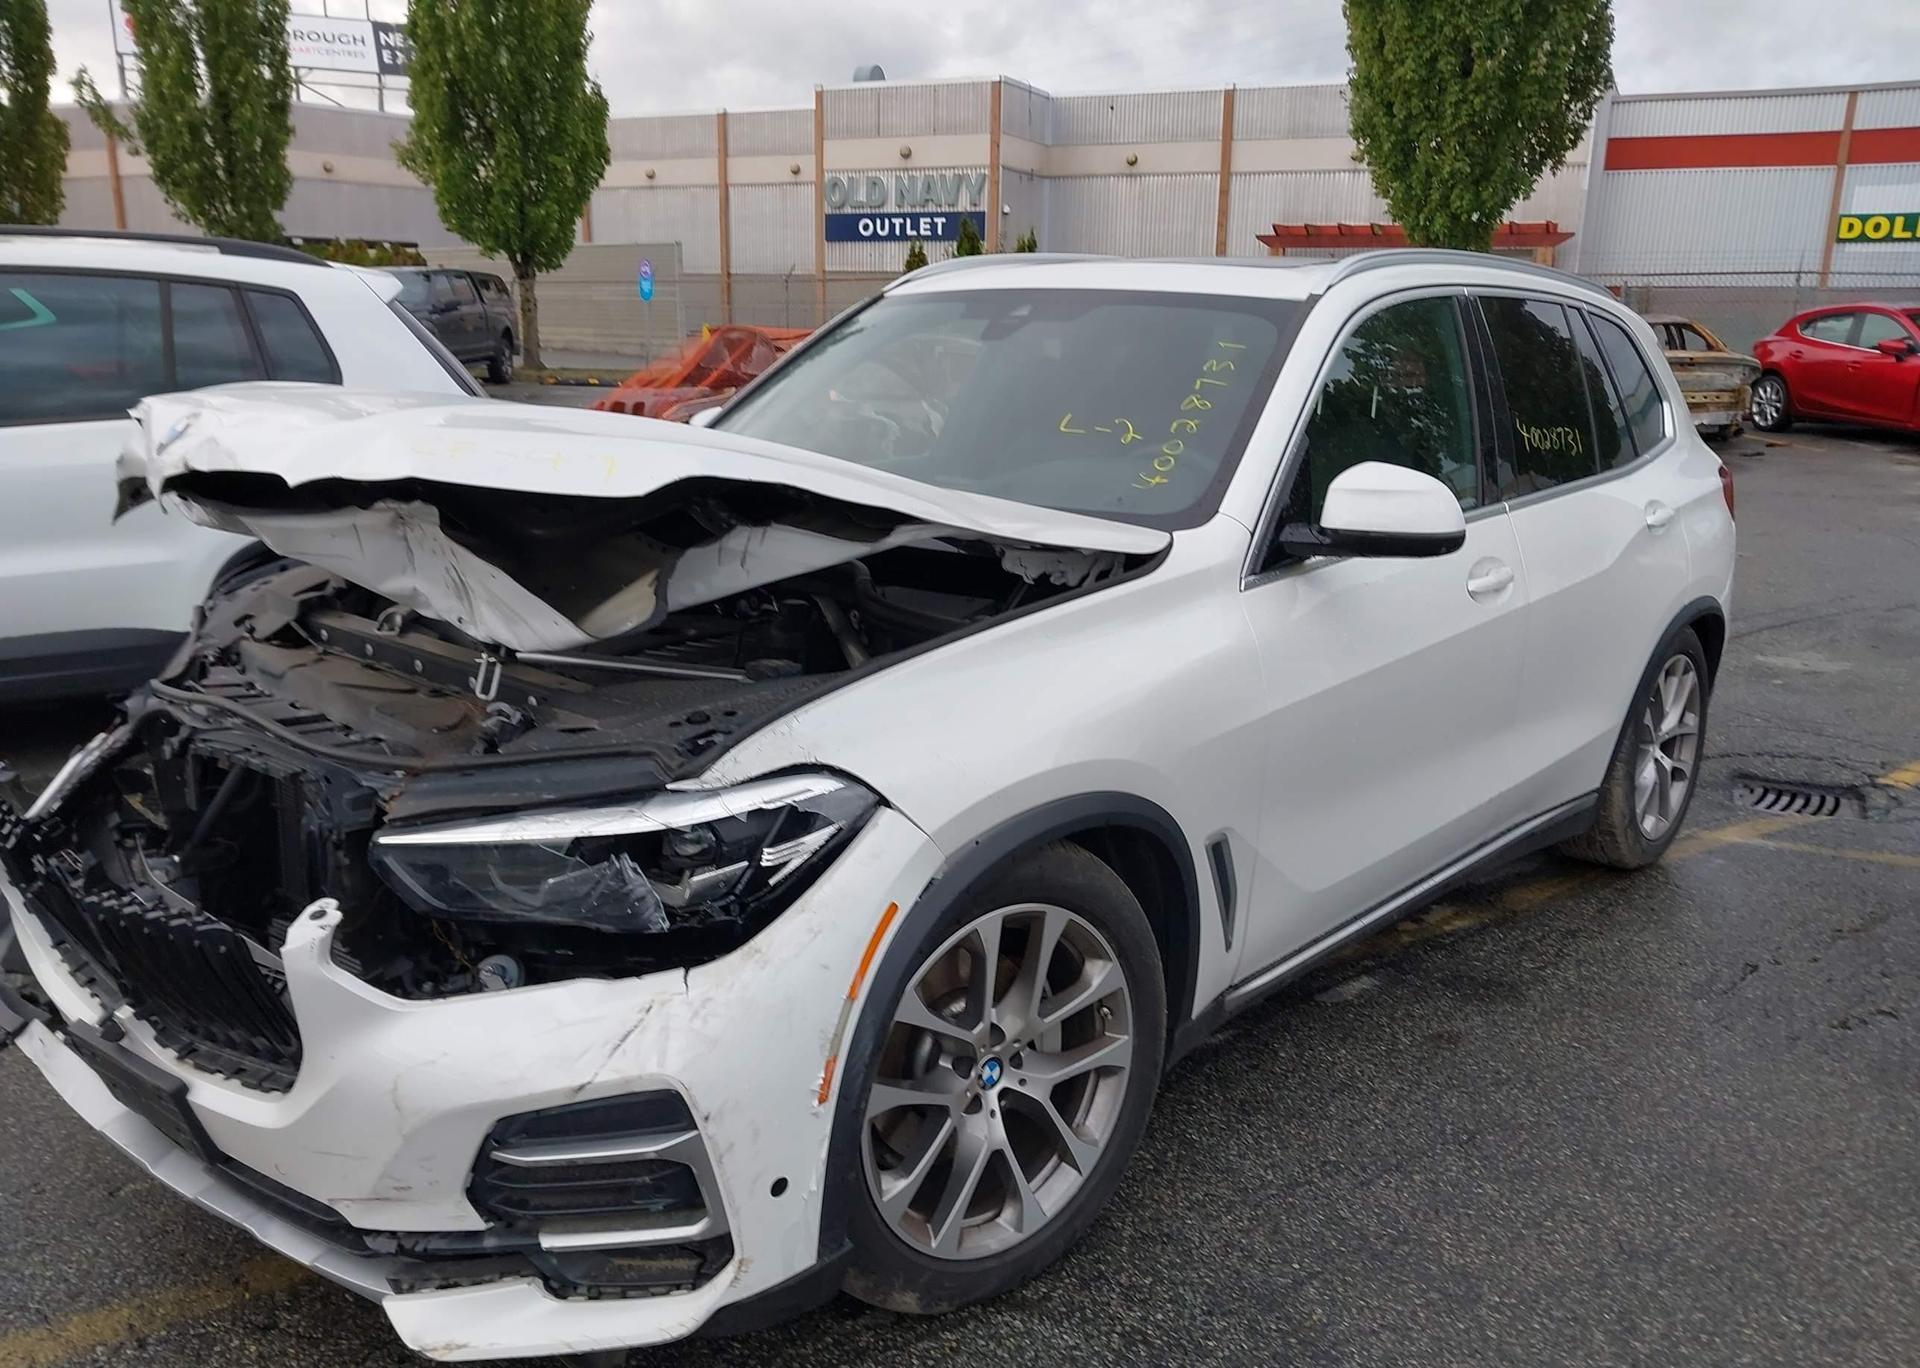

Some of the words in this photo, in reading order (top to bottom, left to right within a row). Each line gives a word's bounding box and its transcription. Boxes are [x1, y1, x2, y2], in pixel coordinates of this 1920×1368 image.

[825, 174, 887, 209] OLD
[895, 172, 987, 208] NAVY
[858, 216, 947, 237] OUTLET
